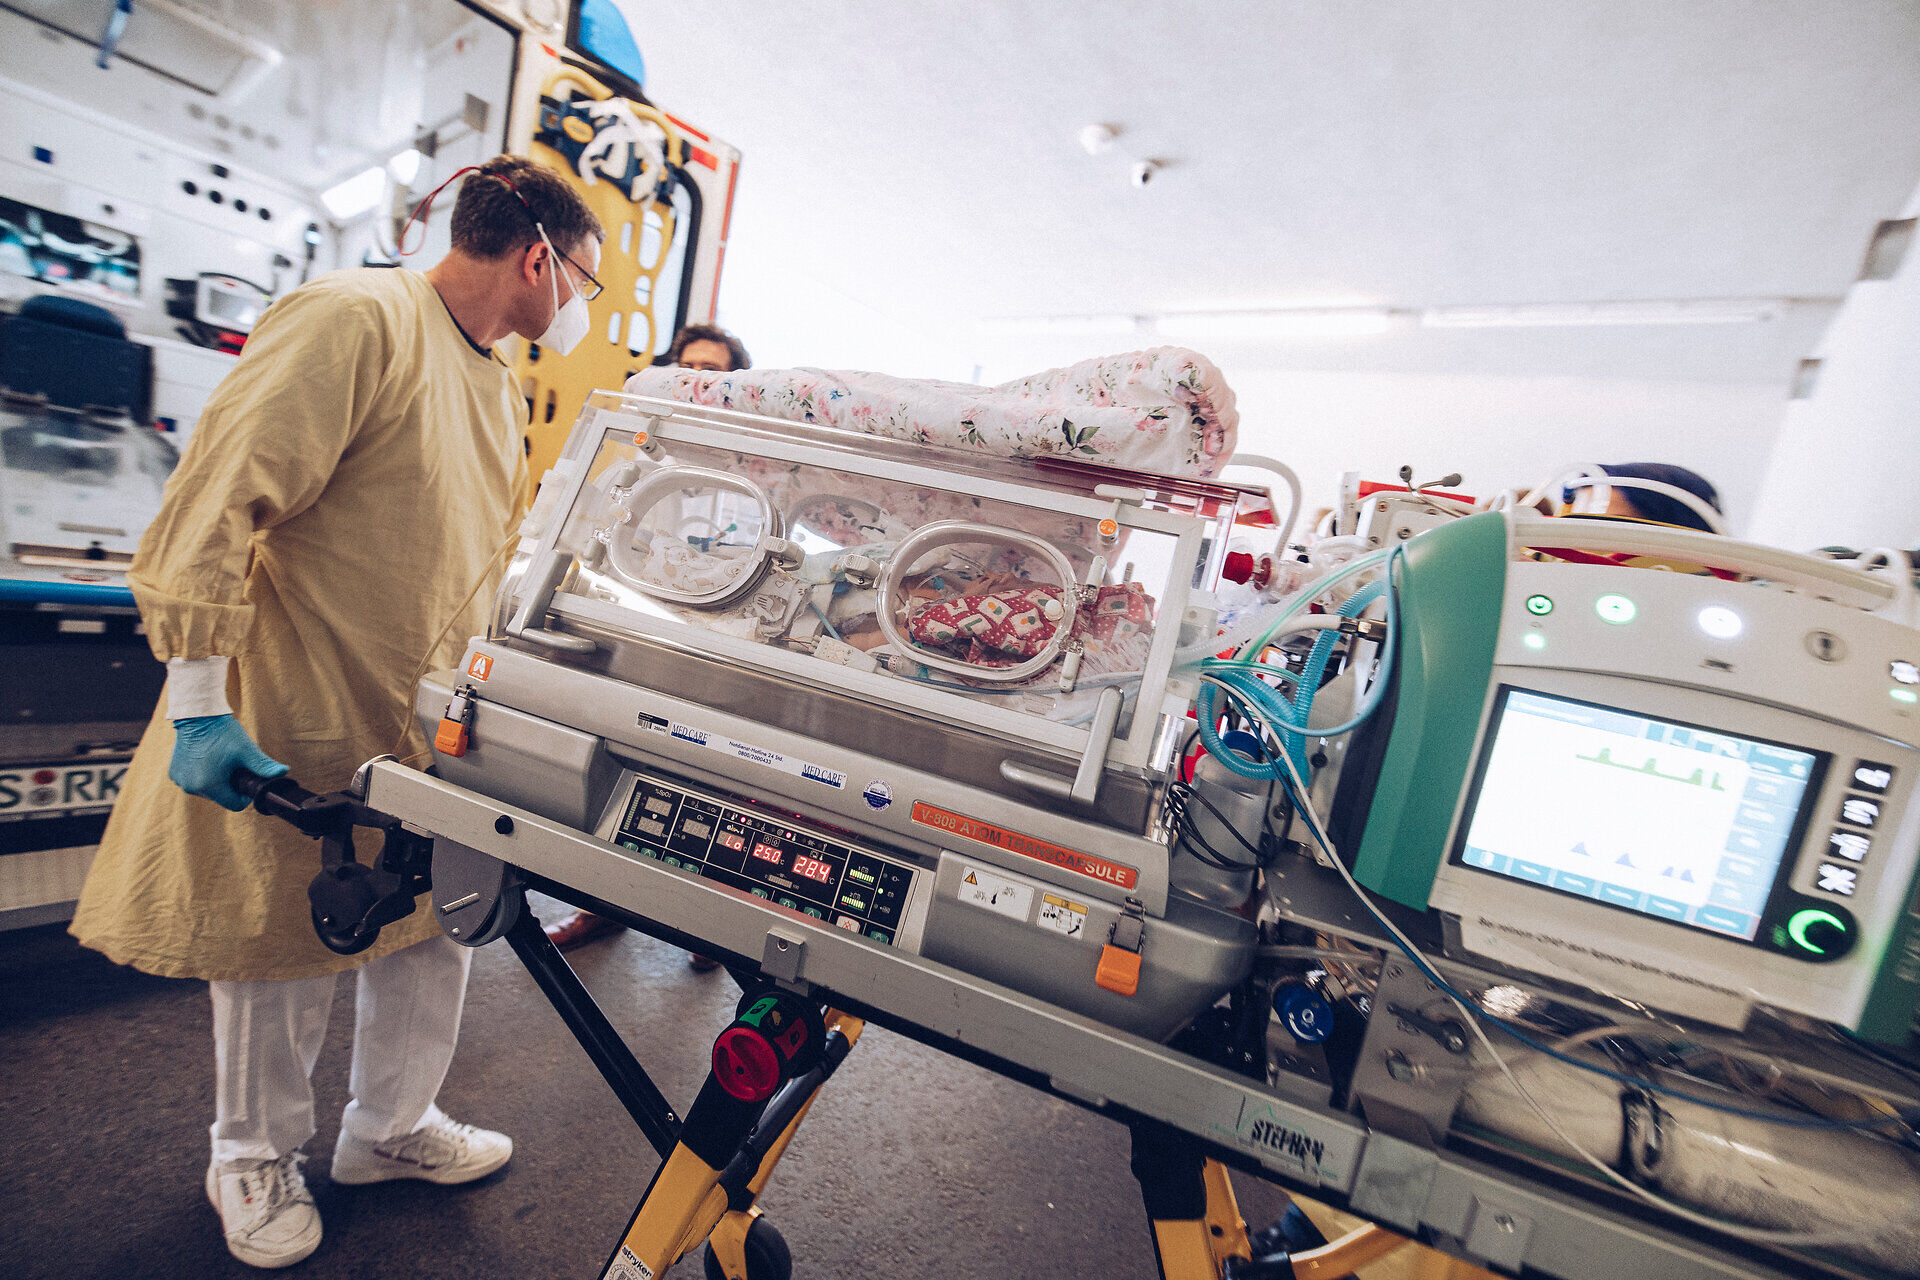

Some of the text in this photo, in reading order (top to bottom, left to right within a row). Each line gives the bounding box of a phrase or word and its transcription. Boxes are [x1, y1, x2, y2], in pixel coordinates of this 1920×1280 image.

[920, 808, 1127, 884] V-808 ATOM TRANSCAPSULE
[621, 1246, 652, 1278] stryker
